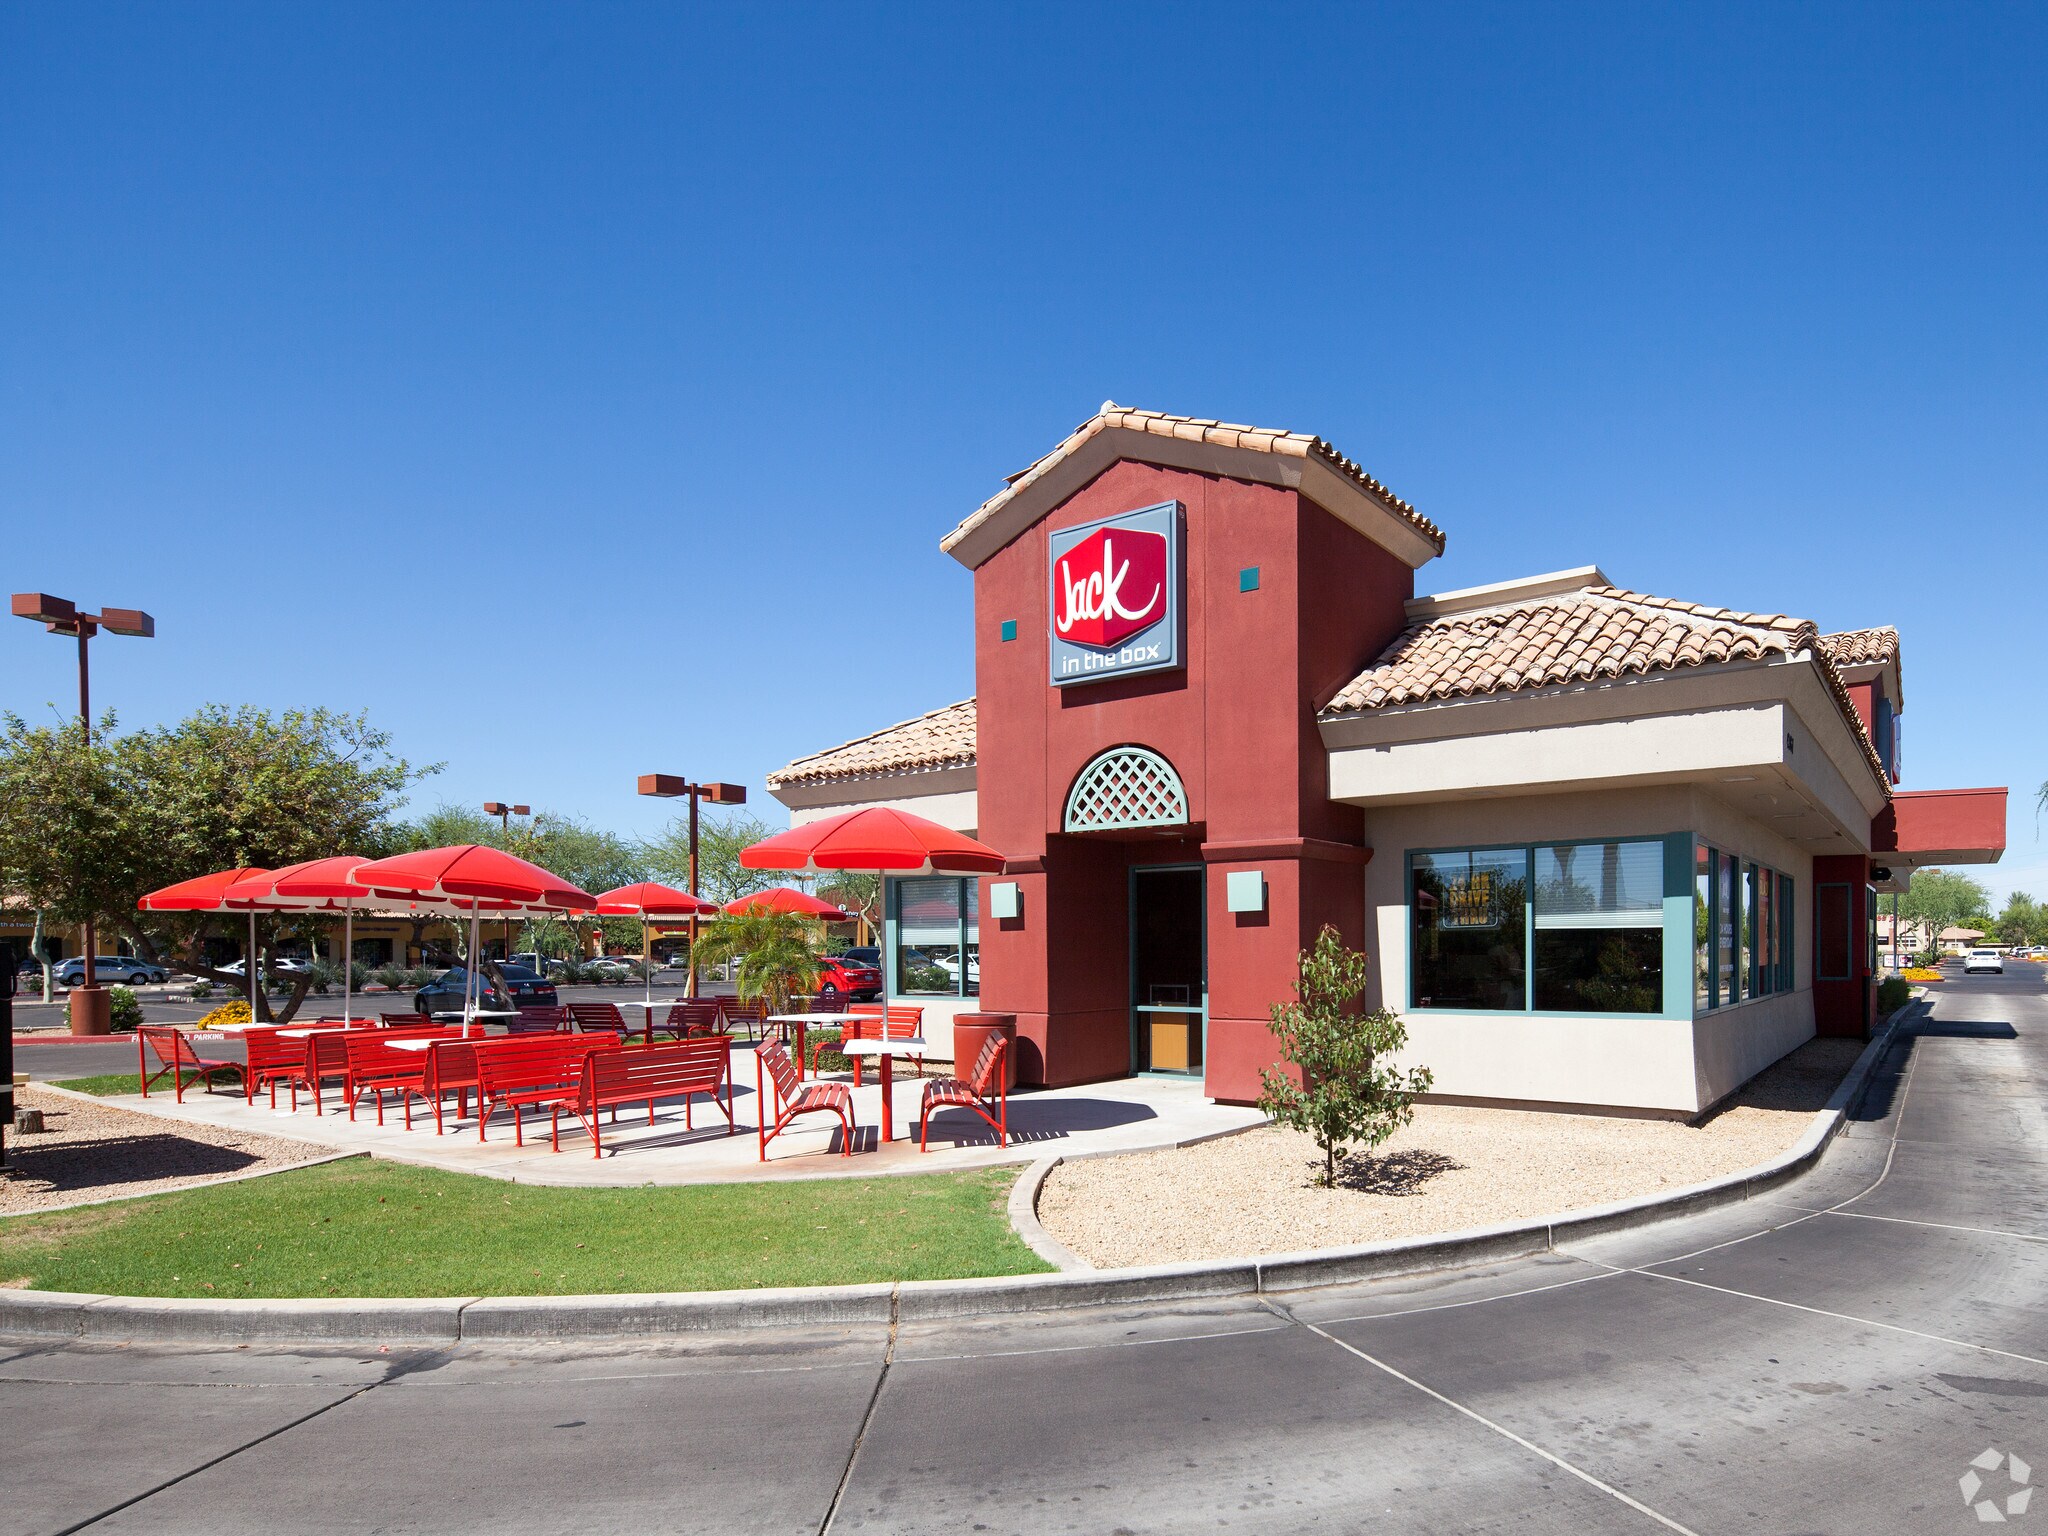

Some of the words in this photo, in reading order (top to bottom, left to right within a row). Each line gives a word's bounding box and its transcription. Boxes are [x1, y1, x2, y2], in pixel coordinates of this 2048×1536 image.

[1057, 538, 1160, 633] Jack
[1062, 655, 1080, 674] in
[1084, 651, 1116, 671] the
[1449, 889, 1489, 907] DRIVE
[193, 1033, 225, 1041] PARKING
